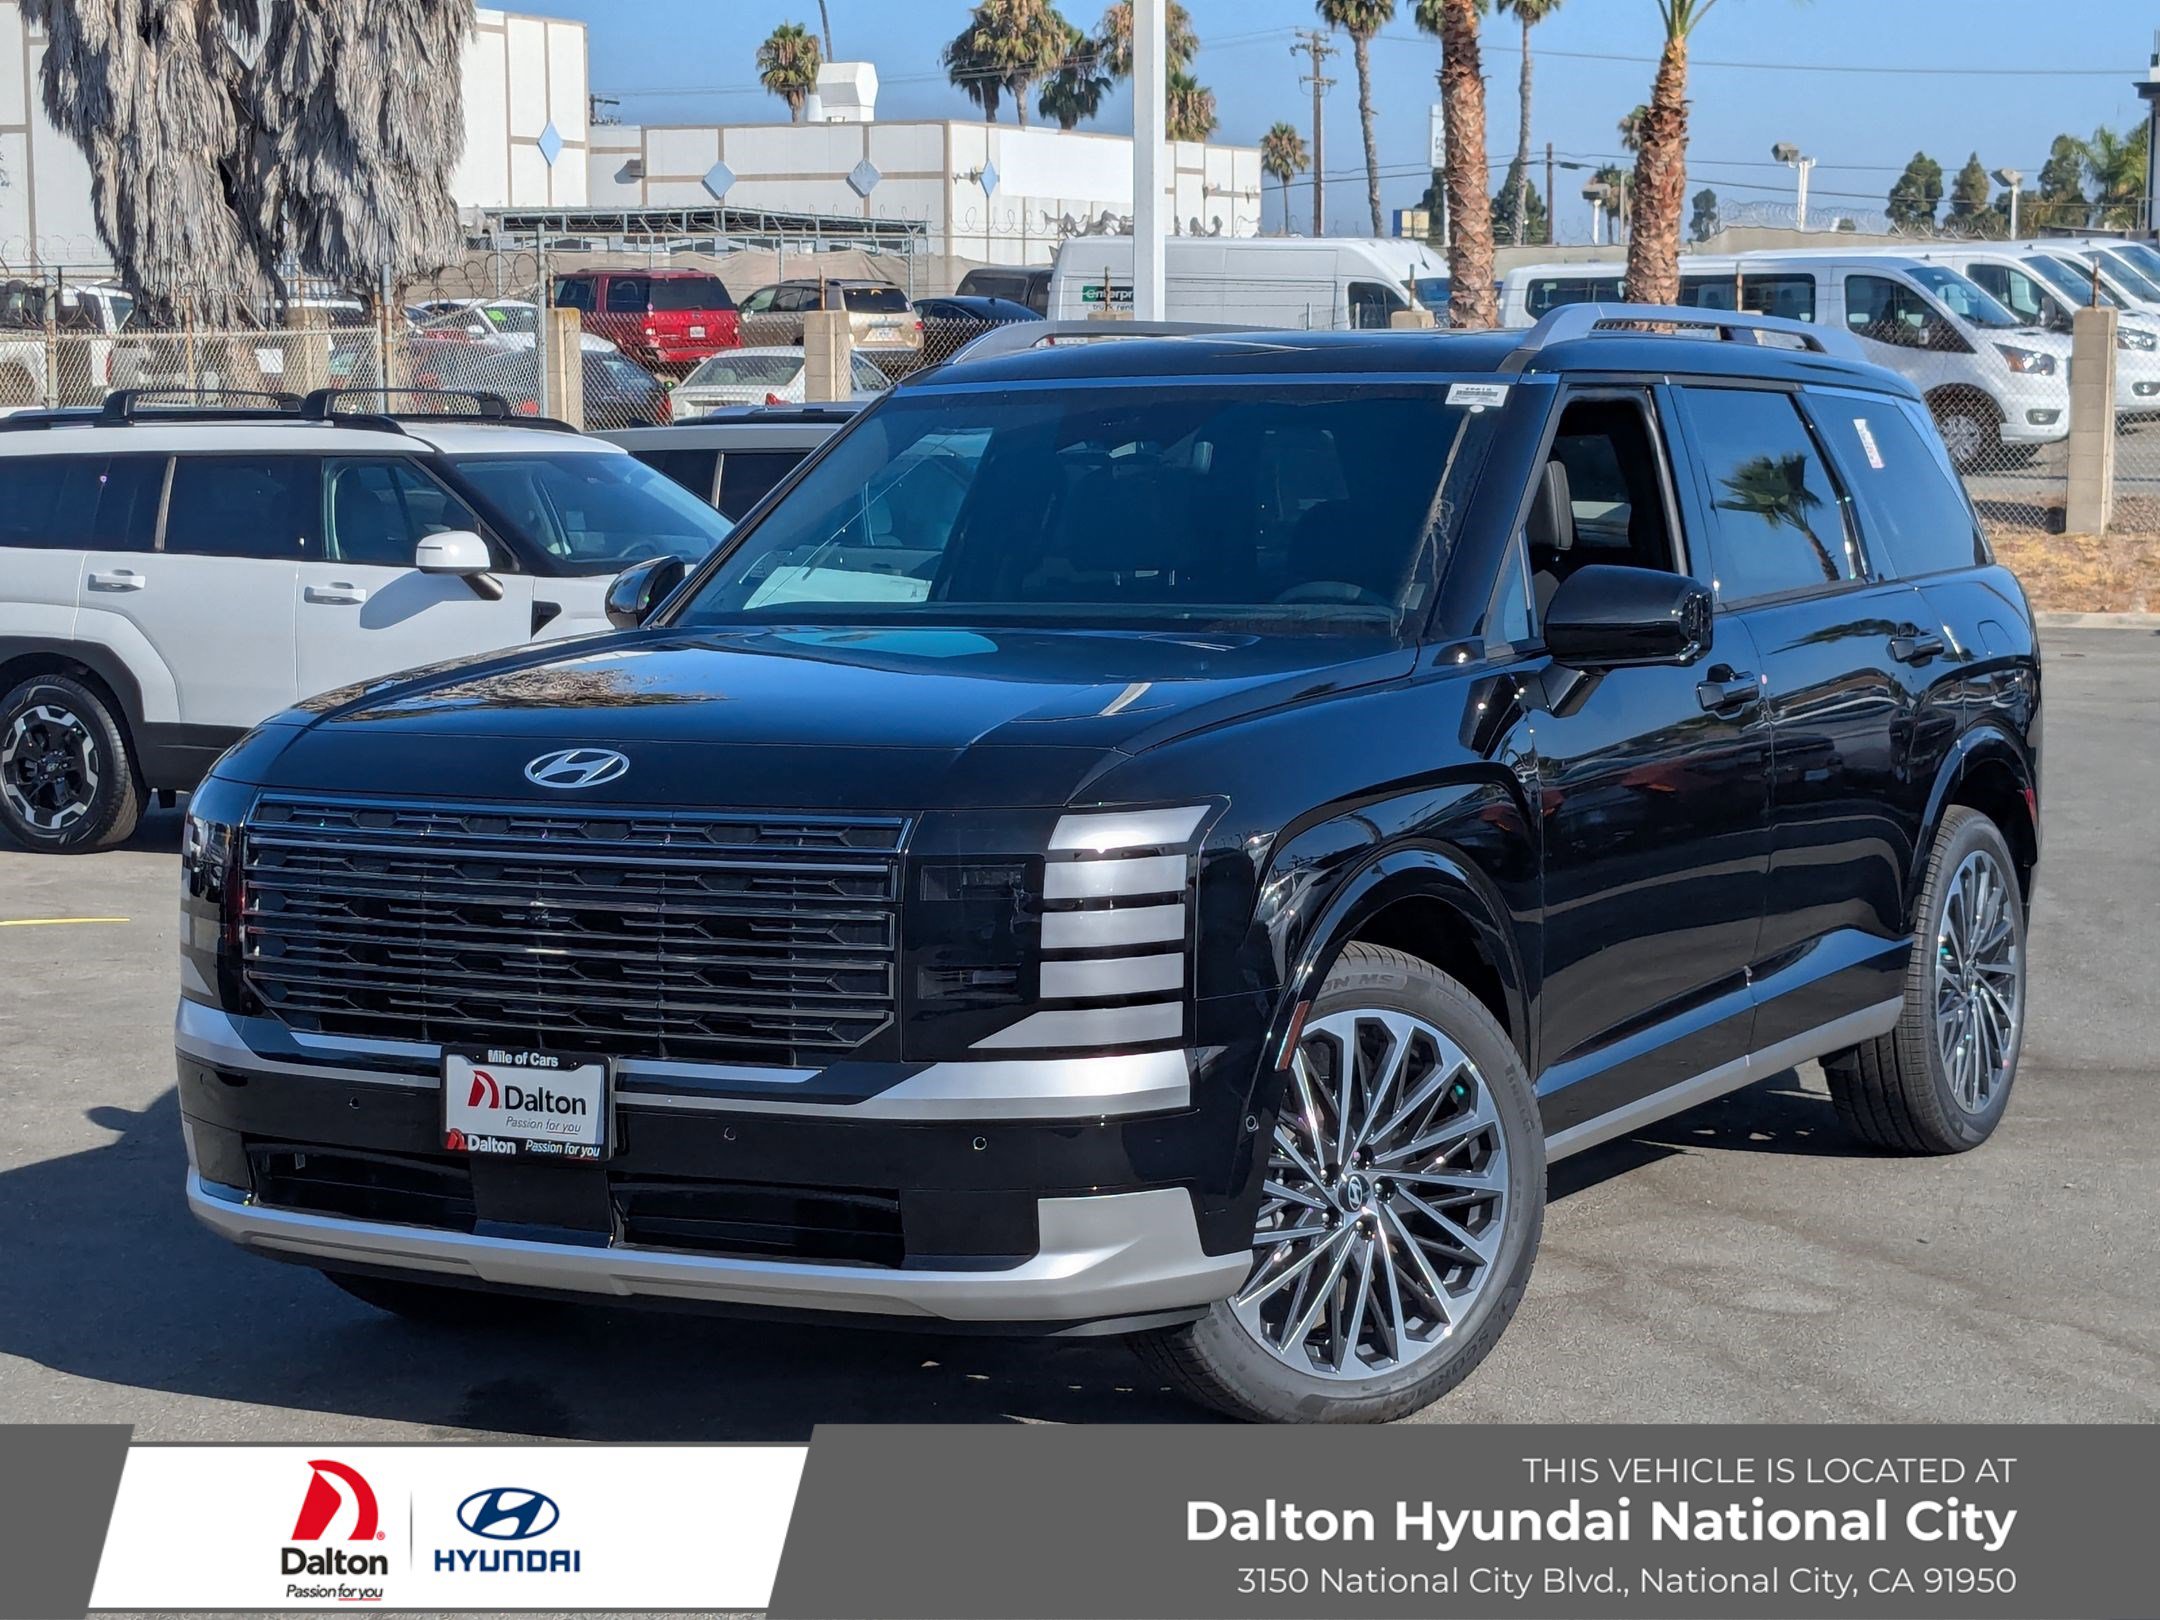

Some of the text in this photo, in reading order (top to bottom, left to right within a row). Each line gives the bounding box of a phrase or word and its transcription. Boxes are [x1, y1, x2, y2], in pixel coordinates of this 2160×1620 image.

[488, 1049, 559, 1067] Mile of Cars
[504, 1085, 587, 1115] Dalton
[505, 1115, 582, 1133] Passion for you
[468, 1135, 516, 1155] Dalton
[525, 1139, 601, 1158] Passion for you
